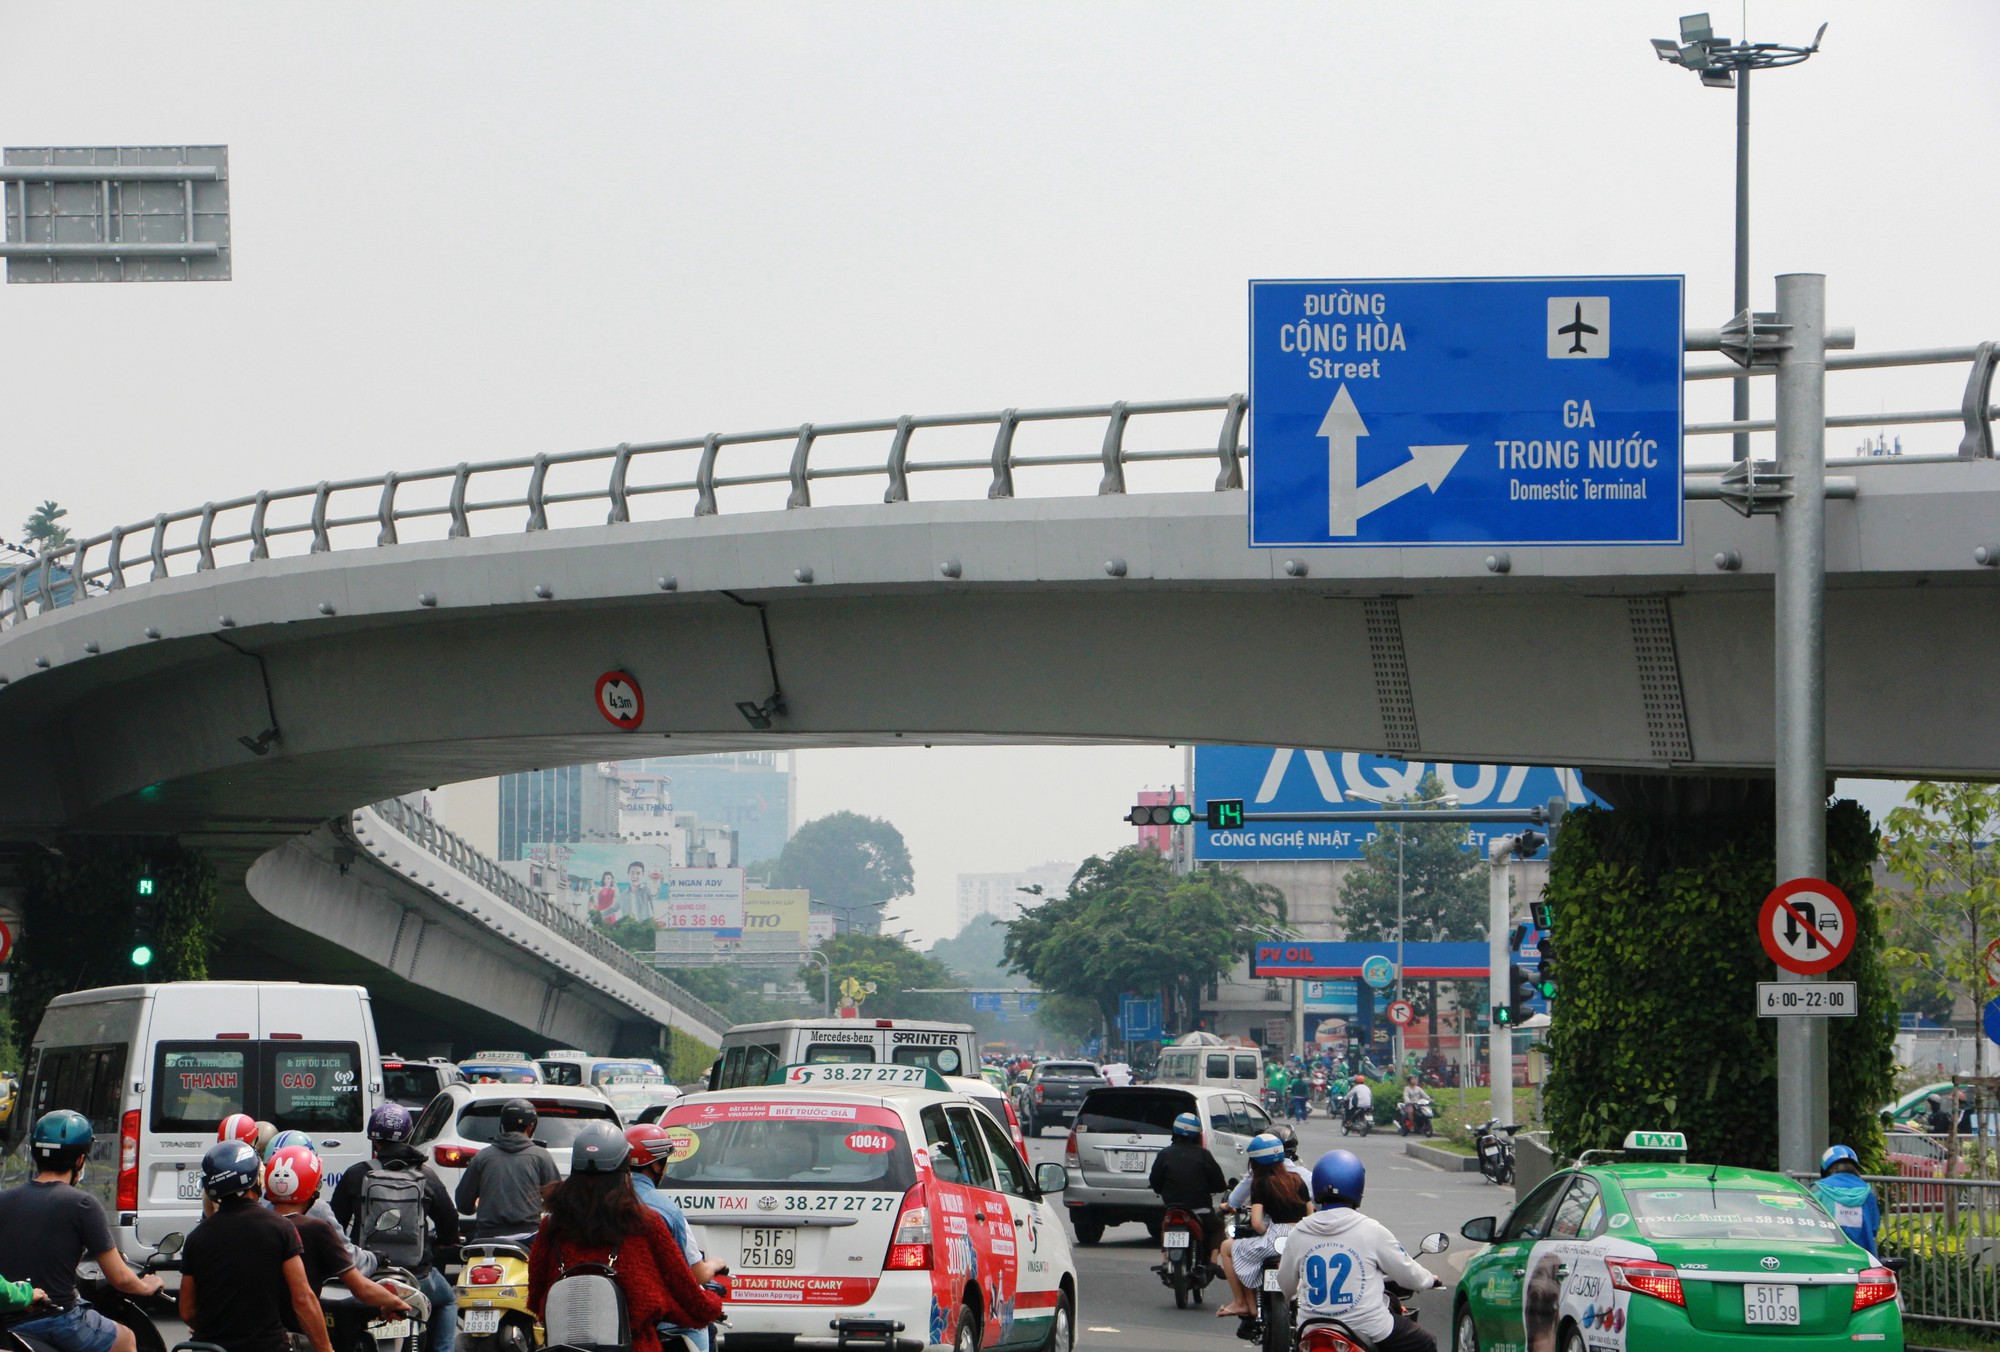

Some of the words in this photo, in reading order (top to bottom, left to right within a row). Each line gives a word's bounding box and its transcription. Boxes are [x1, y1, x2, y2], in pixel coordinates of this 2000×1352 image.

[1304, 289, 1386, 315] ĐƯỜNG
[1281, 318, 1347, 357] CỘNG
[1356, 315, 1407, 352] HÒA
[1308, 357, 1381, 379] Street
[1563, 399, 1596, 428] GA
[1494, 440, 1579, 469] TRONG
[1588, 431, 1659, 469] NƯỚC
[1510, 478, 1579, 501] Domestic
[1584, 478, 1647, 501] Terminal
[1210, 830, 1255, 847] CÔNG
[1260, 830, 1304, 849] NGHỆ
[1308, 830, 1351, 849] NHẬT
[705, 879, 723, 887] ADV
[672, 915, 686, 927] 16
[691, 915, 705, 927] 36
[710, 915, 726, 927] 96
[1260, 947, 1281, 962] PV
[1286, 947, 1314, 962] OIL
[810, 1031, 874, 1044] Mercedes-benz
[892, 1032, 958, 1045] SPRINTER
[309, 1059, 320, 1068] DU
[180, 1072, 238, 1089] THANH
[282, 1072, 316, 1089] CAO
[822, 1068, 872, 1083] 38.27
[876, 1069, 899, 1083] 27
[902, 1070, 925, 1084] 27
[850, 1134, 887, 1149] 10041
[717, 1196, 748, 1210] TAXI
[784, 1196, 838, 1211] 38.27
[844, 1197, 866, 1212] 27
[871, 1197, 896, 1213] 27
[1755, 1215, 1772, 1223] 38
[1777, 1216, 1794, 1225] 38
[1798, 1217, 1815, 1226] 38
[1818, 1219, 1836, 1230] 38
[754, 1230, 783, 1247] 51F
[743, 1248, 794, 1267] 751.69
[745, 1278, 768, 1288] TAXI
[771, 1277, 805, 1289] TRÚNG
[807, 1279, 844, 1290] CAMRY
[1306, 1252, 1354, 1306] 92
[770, 1292, 783, 1300] App
[1757, 1287, 1784, 1304] 51F
[1748, 1304, 1798, 1322] 510.39
[465, 1321, 496, 1332] 299.69
